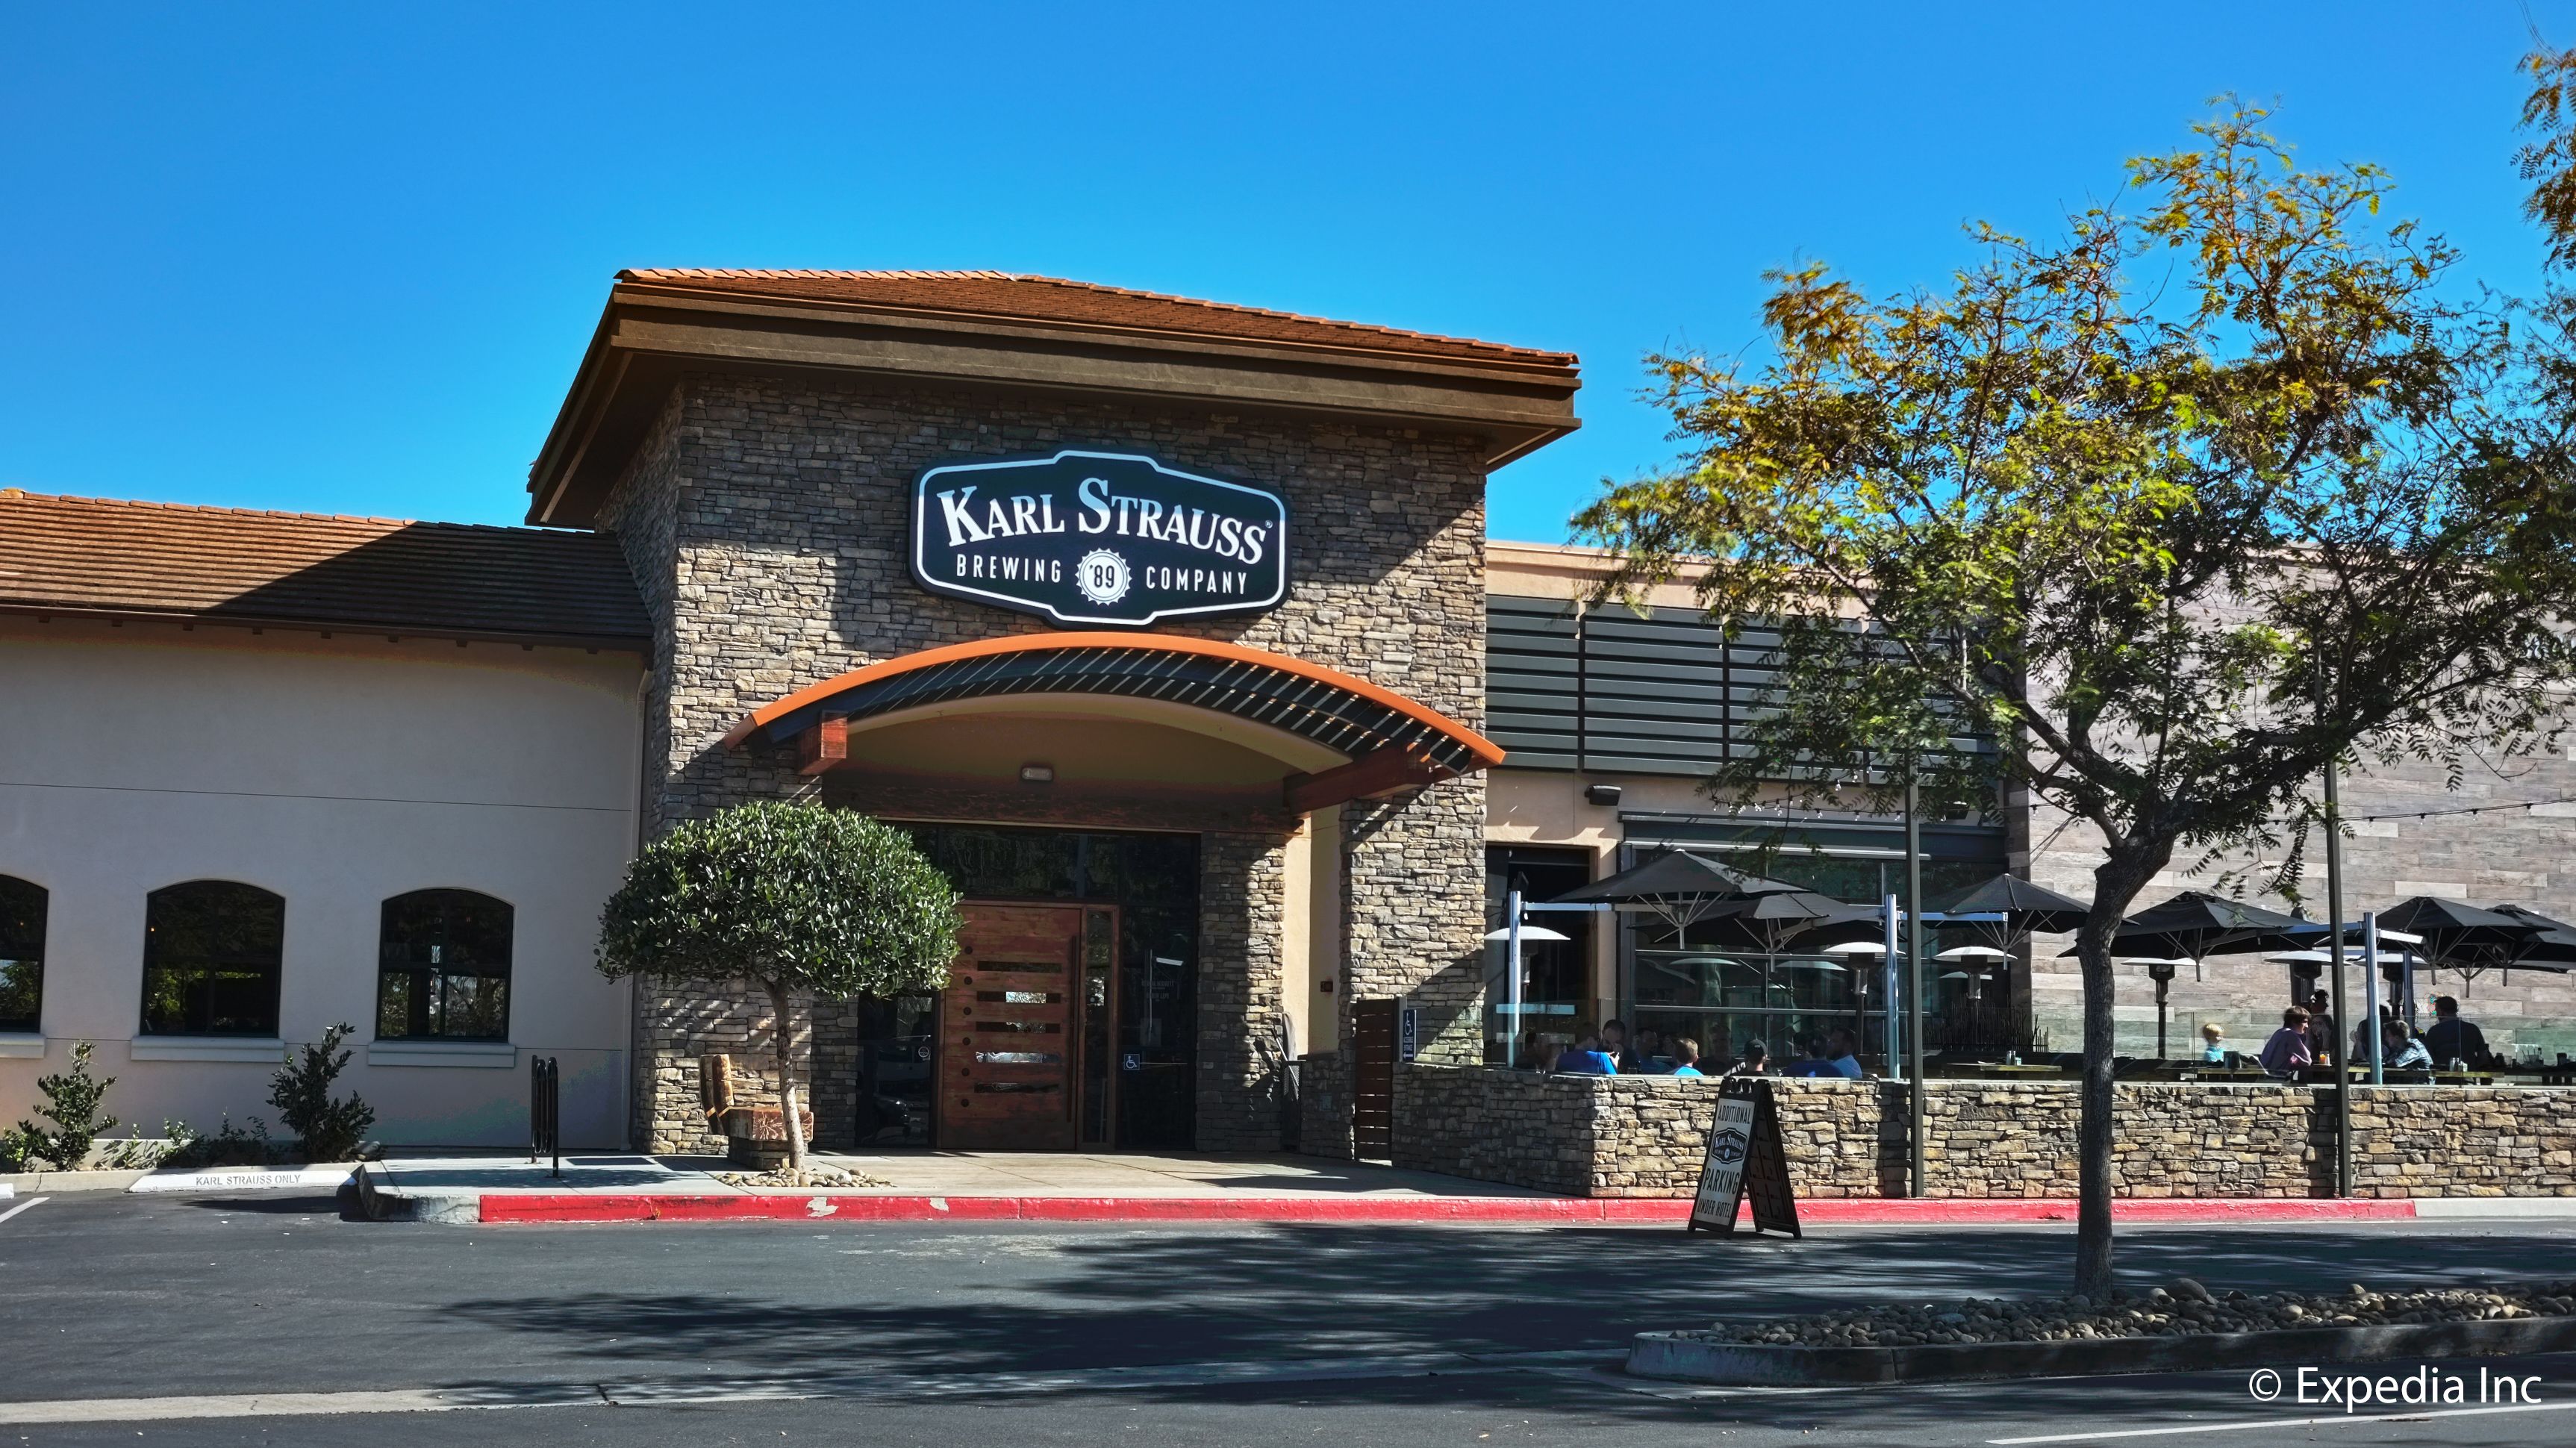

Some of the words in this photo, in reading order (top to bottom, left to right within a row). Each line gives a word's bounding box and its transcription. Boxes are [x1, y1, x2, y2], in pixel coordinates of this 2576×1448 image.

[956, 554, 1061, 583] BREWING
[1146, 567, 1247, 594] COMPANY
[1718, 1105, 1750, 1124] ADDITIONAL
[196, 1177, 222, 1185] KARL
[226, 1175, 272, 1185] STRAUSS
[275, 1175, 301, 1184] ONLY
[1703, 1167, 1740, 1194] PARKING
[1697, 1198, 1716, 1214] UNDER
[1716, 1202, 1733, 1218] HOTEL
